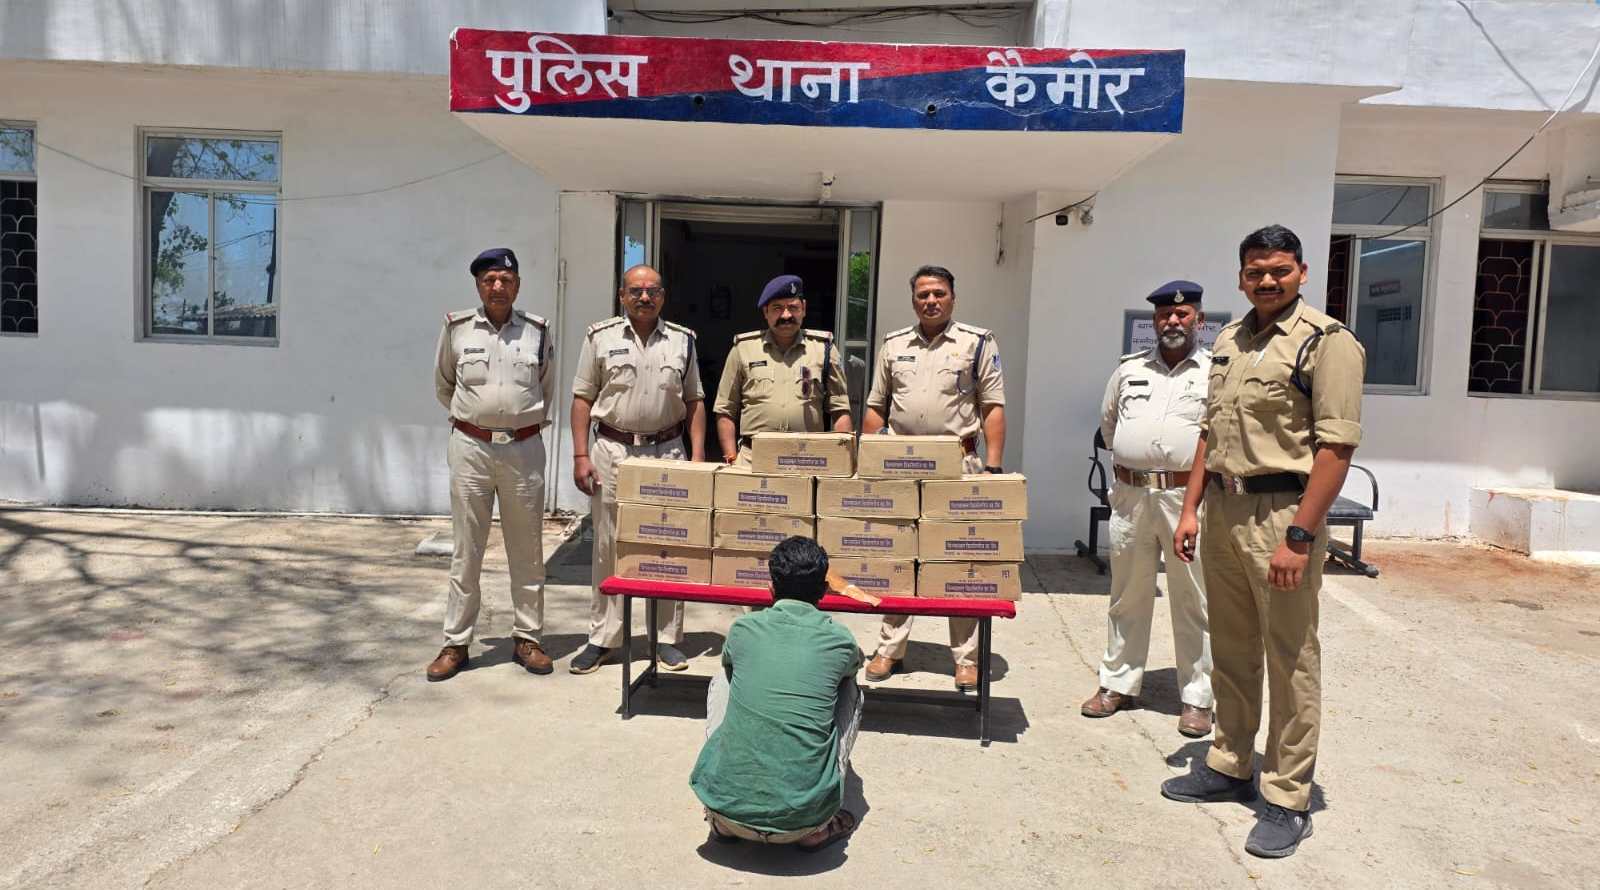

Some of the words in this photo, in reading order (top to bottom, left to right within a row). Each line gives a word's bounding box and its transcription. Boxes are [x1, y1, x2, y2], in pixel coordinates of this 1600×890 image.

[486, 35, 649, 114] पुलिस
[729, 54, 870, 105] थाना
[986, 49, 1146, 115] कैमोर
